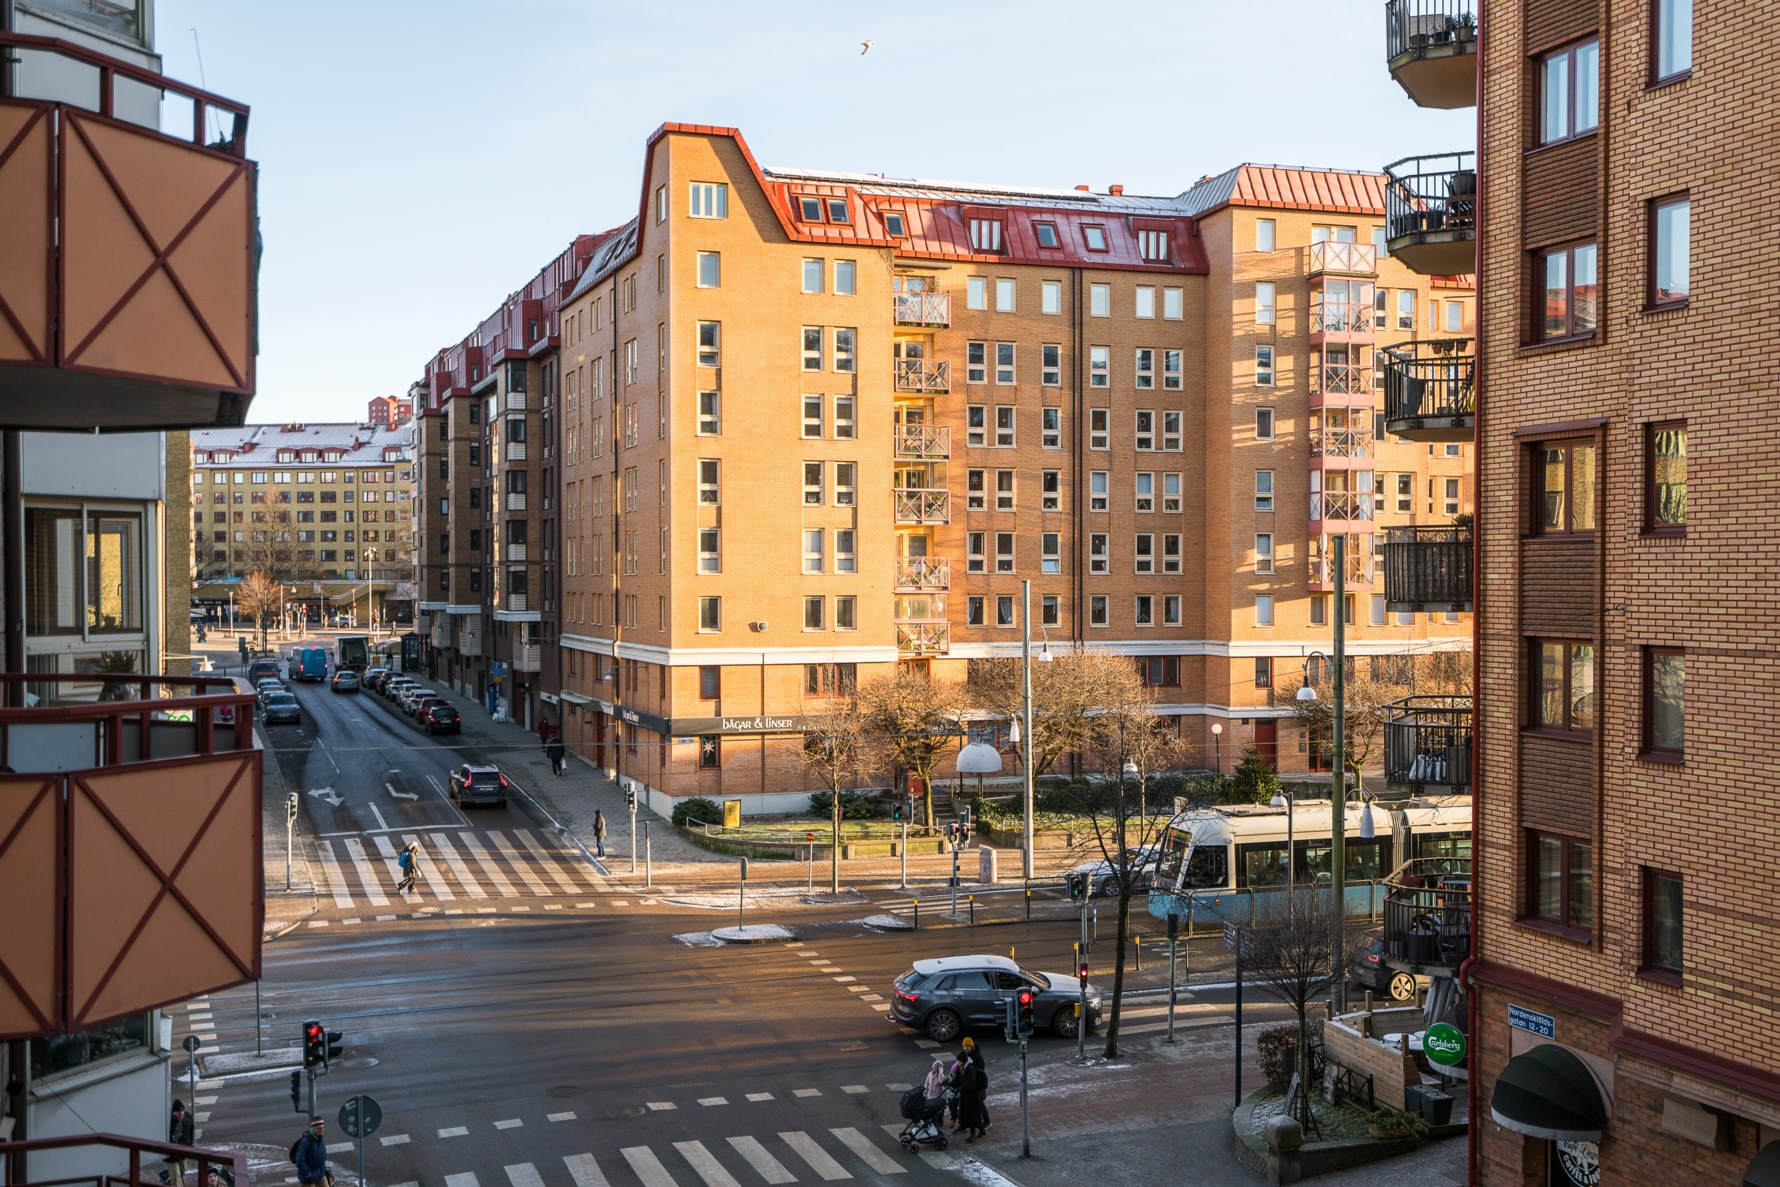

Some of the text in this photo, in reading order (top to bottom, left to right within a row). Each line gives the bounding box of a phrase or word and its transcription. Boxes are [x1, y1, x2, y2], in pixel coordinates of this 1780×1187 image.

[754, 717, 763, 729] &
[1509, 1017, 1527, 1027] gatan
[1428, 1036, 1461, 1052] Carlsberg
[1563, 1140, 1598, 1160] Café Linn
[1563, 1154, 1583, 1182] COFFEE
[1583, 1175, 1589, 1184] &
